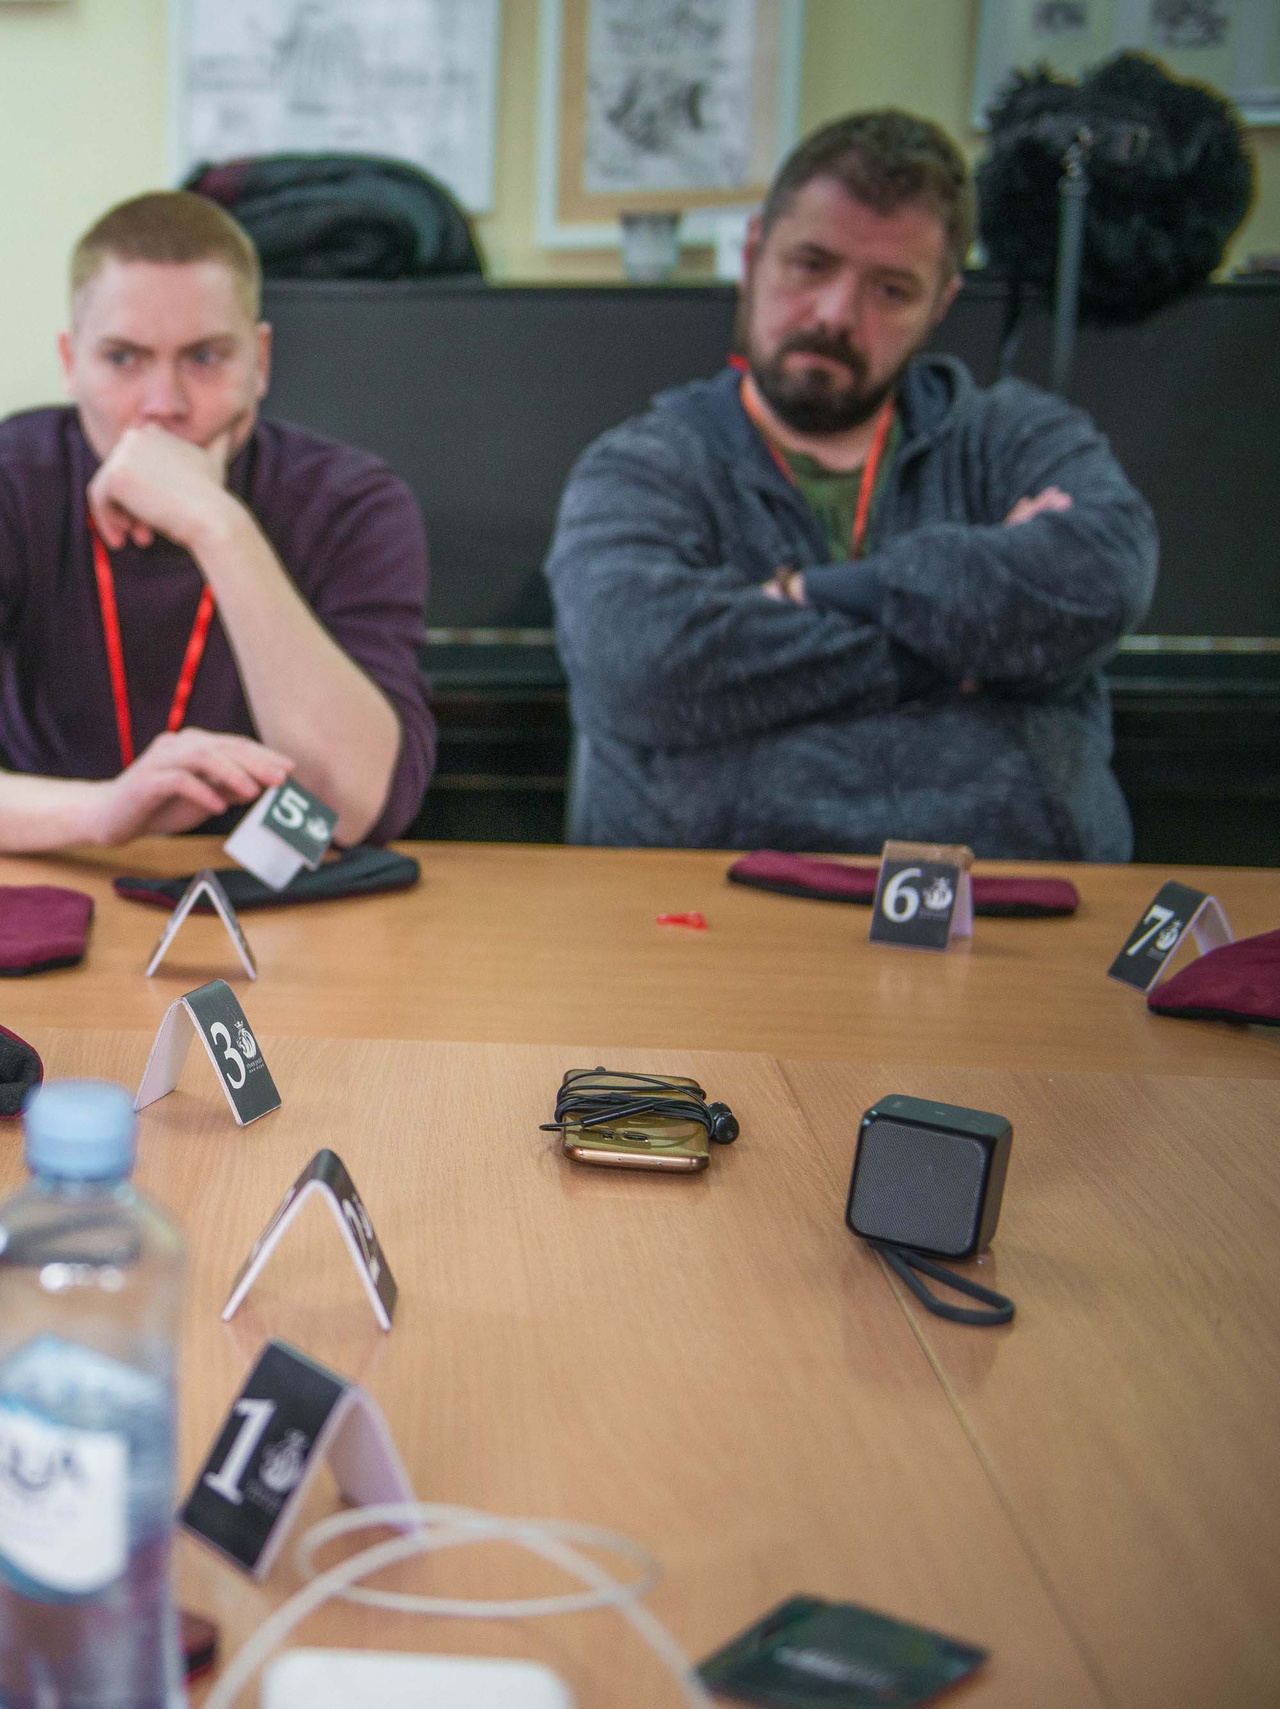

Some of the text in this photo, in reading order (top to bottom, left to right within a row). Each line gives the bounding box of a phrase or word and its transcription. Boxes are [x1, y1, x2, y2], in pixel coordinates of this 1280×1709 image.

[272, 787, 309, 829] 5
[882, 867, 922, 923] 6
[1126, 904, 1175, 956] 7
[210, 1021, 246, 1089] 3
[203, 1397, 277, 1506] 1
